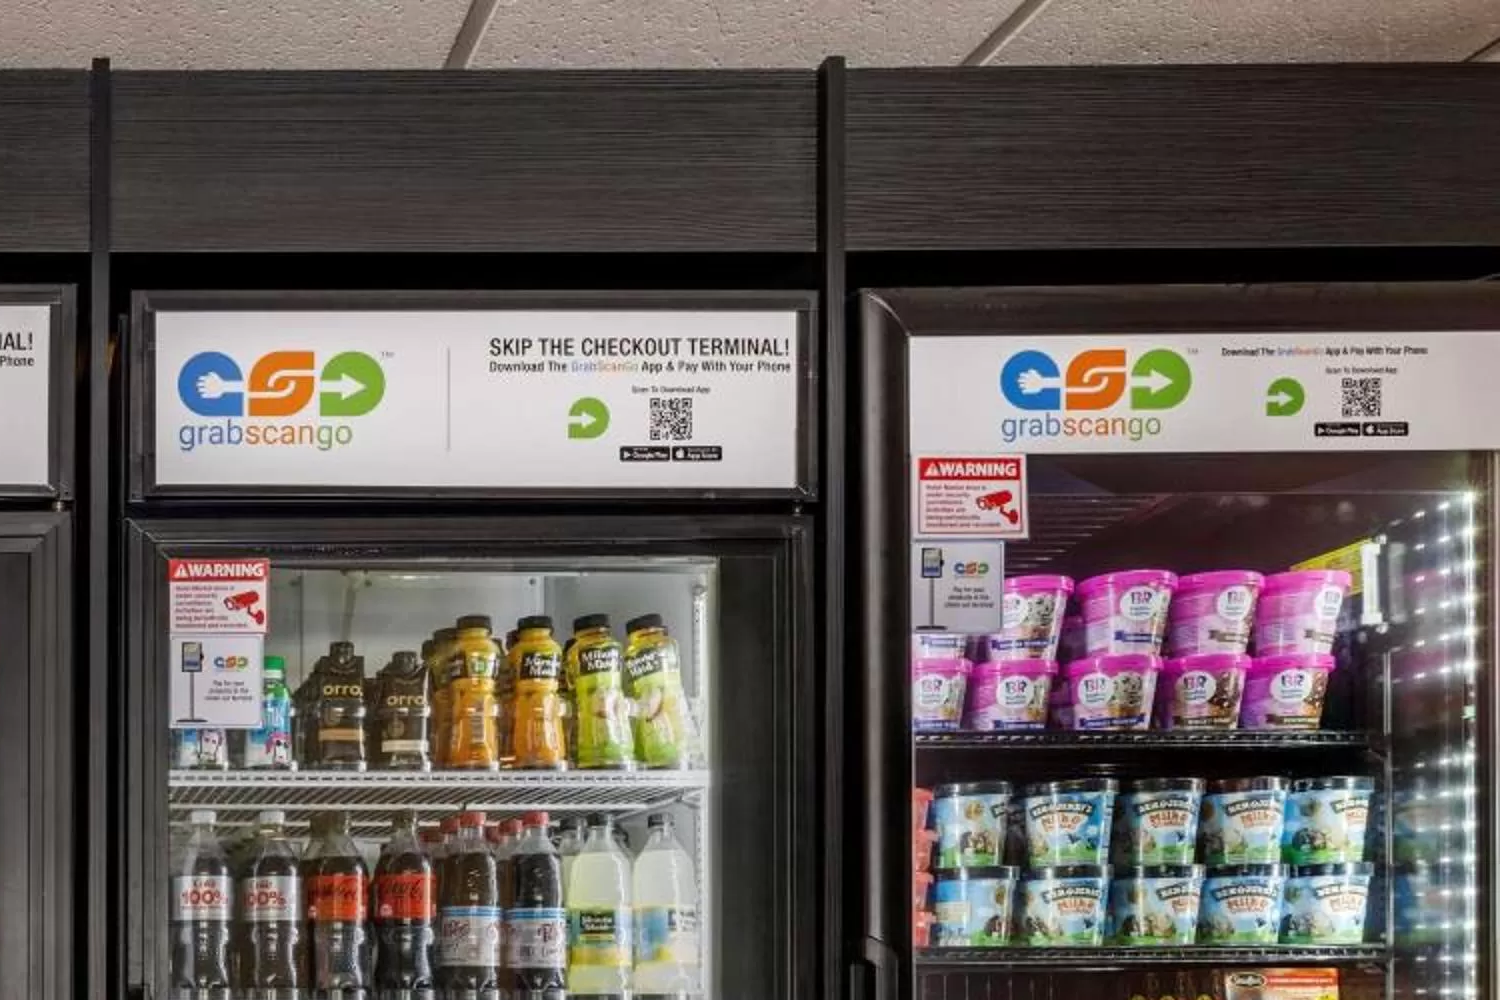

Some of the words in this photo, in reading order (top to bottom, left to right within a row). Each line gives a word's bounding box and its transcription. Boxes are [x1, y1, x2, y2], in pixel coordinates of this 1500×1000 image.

[489, 338, 532, 357] SKIP
[538, 338, 575, 357] THE
[581, 338, 683, 357] CHECKOUT
[687, 338, 790, 357] TERMINAL!
[0, 355, 35, 368] Phone
[489, 361, 545, 373] Download
[547, 361, 568, 373] The
[641, 361, 664, 374] App
[667, 361, 675, 373] &
[678, 361, 699, 374] Pay
[701, 361, 727, 373] With
[730, 361, 754, 373] Your
[757, 361, 791, 373] Phone
[178, 420, 353, 452] grabscango
[1001, 414, 1162, 443] grabscango
[937, 463, 1017, 477] WARNING
[188, 562, 265, 577] WARNING
